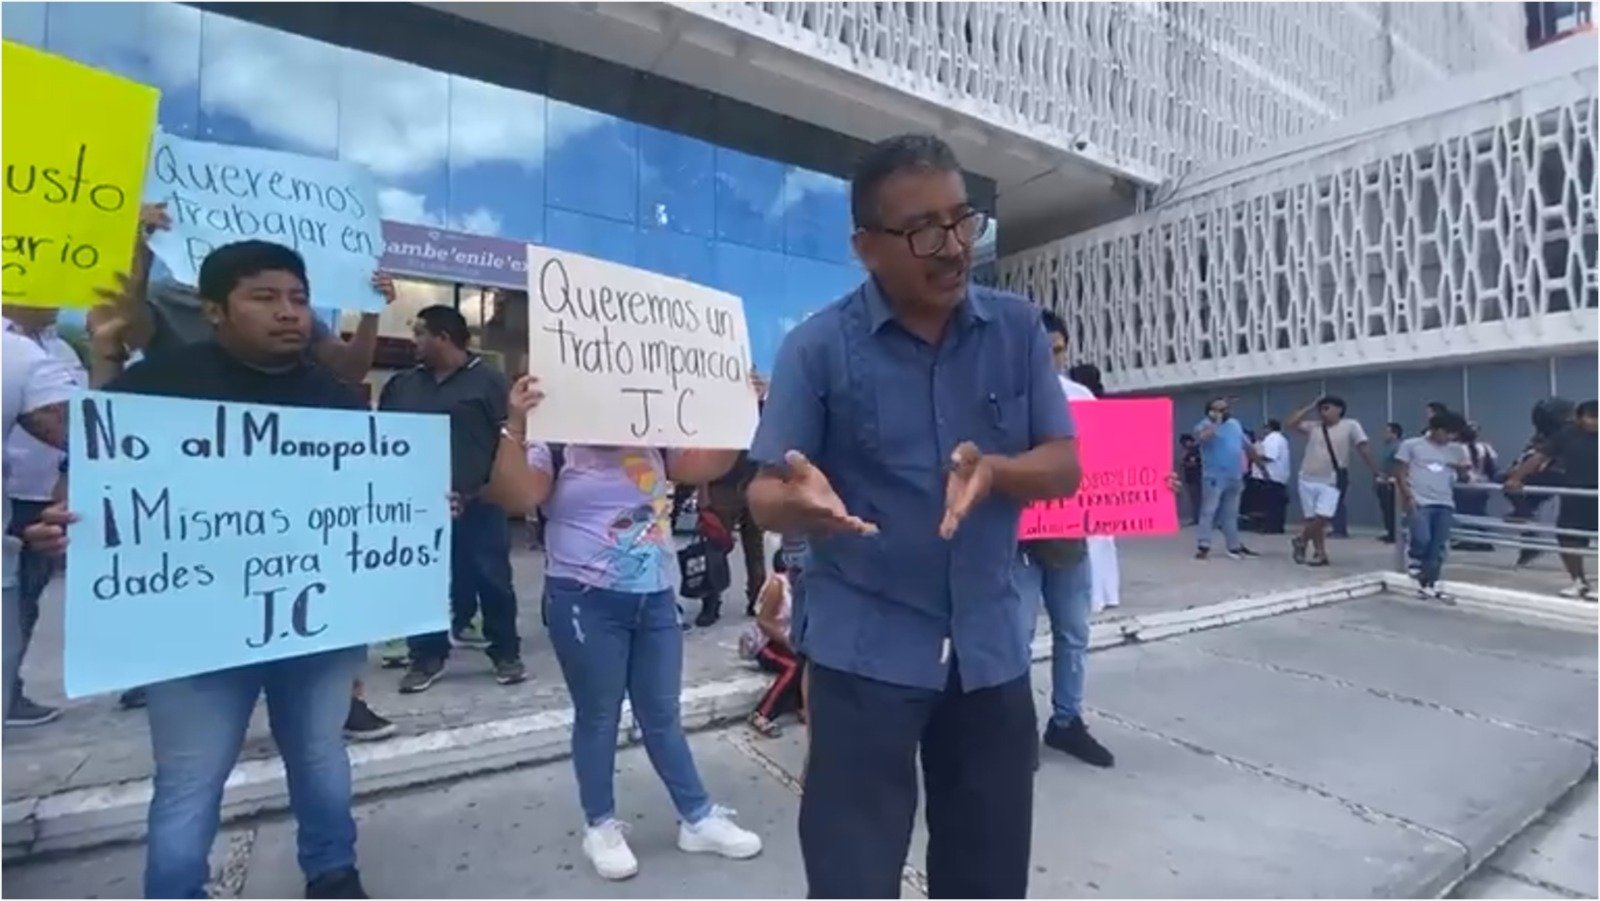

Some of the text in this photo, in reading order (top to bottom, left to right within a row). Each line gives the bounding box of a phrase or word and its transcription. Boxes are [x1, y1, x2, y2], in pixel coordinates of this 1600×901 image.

[153, 144, 366, 219] Queremos
[164, 190, 374, 256] trabajar en
[539, 257, 735, 341] Queremos un
[542, 319, 749, 391] trato imparcial
[82, 397, 411, 472] No al Monopolio
[307, 481, 428, 546] oportuni-
[92, 527, 444, 601] dades para todos!
